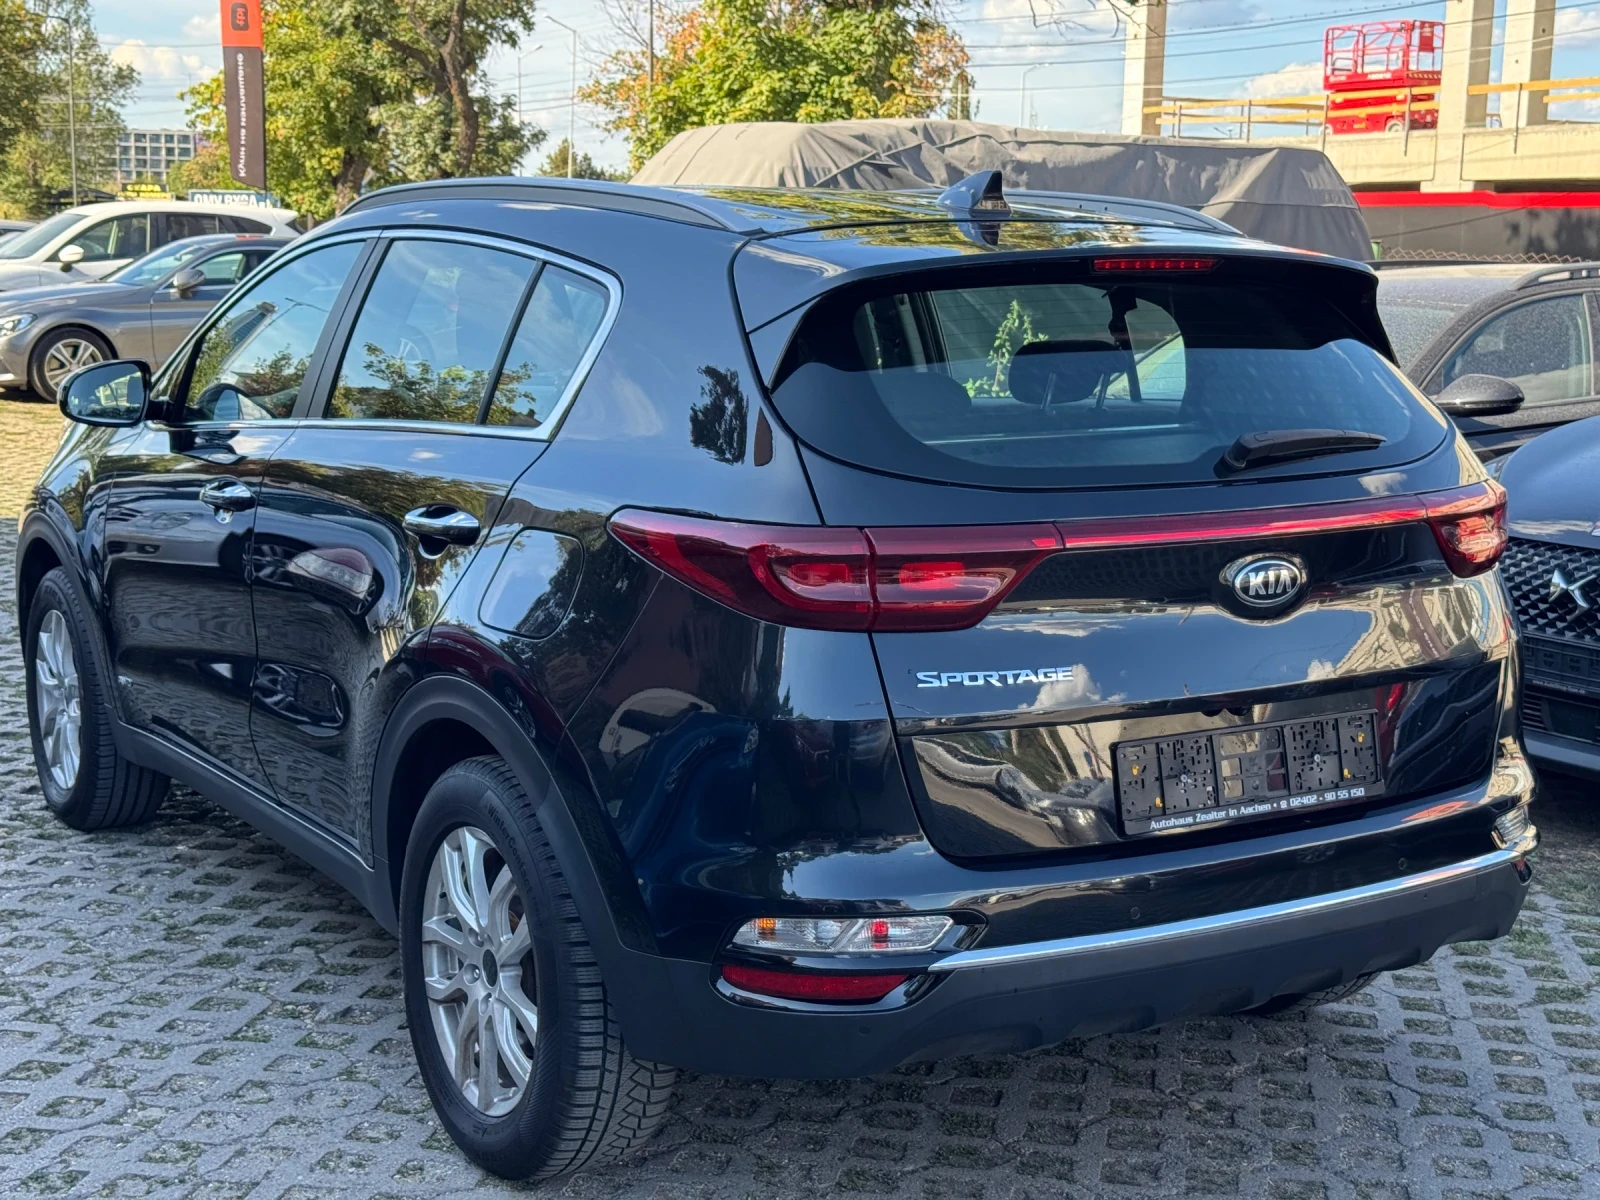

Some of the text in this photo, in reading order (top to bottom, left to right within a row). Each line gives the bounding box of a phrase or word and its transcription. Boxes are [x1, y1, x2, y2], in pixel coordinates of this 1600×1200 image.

[1247, 569, 1292, 596] KIA
[916, 666, 1075, 688] SPORTAGE
[1149, 787, 1365, 831] Autohaus Zeaiter in Aachen 02402 90 55 150
